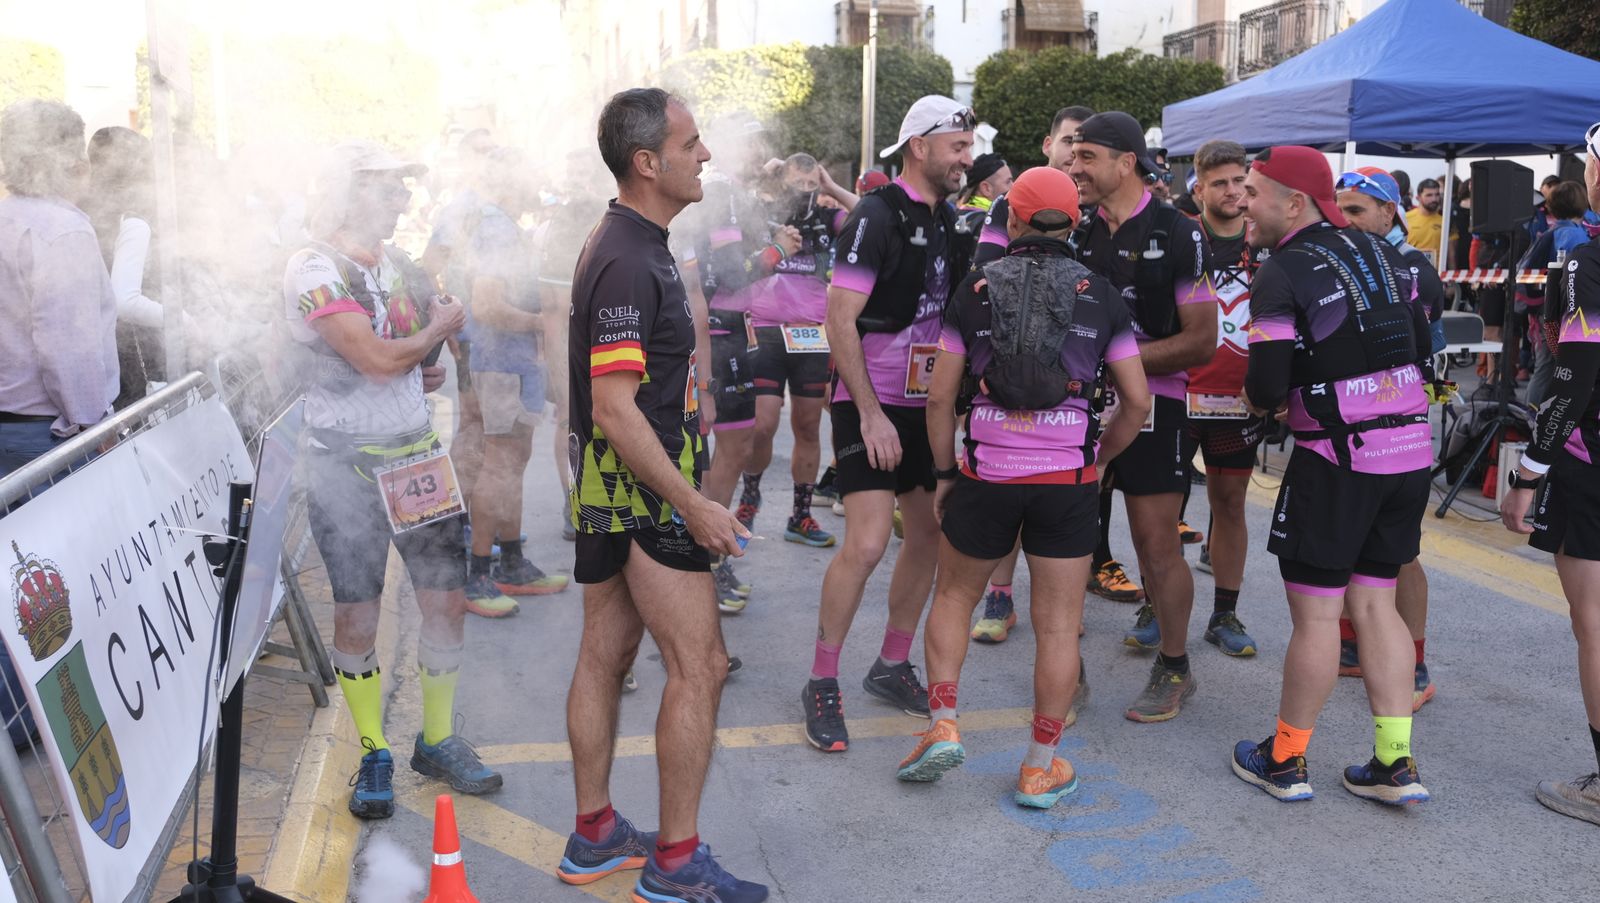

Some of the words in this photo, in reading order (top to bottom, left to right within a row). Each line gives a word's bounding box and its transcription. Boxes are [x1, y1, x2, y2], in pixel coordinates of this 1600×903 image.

[791, 328, 820, 338] 382
[1346, 377, 1378, 396] MTB
[1034, 411, 1083, 426] TRAIL
[1562, 420, 1575, 437] 2023
[406, 474, 437, 497] 43
[89, 467, 219, 617] AYUNTAMIENTO
[108, 517, 229, 721] CANT
